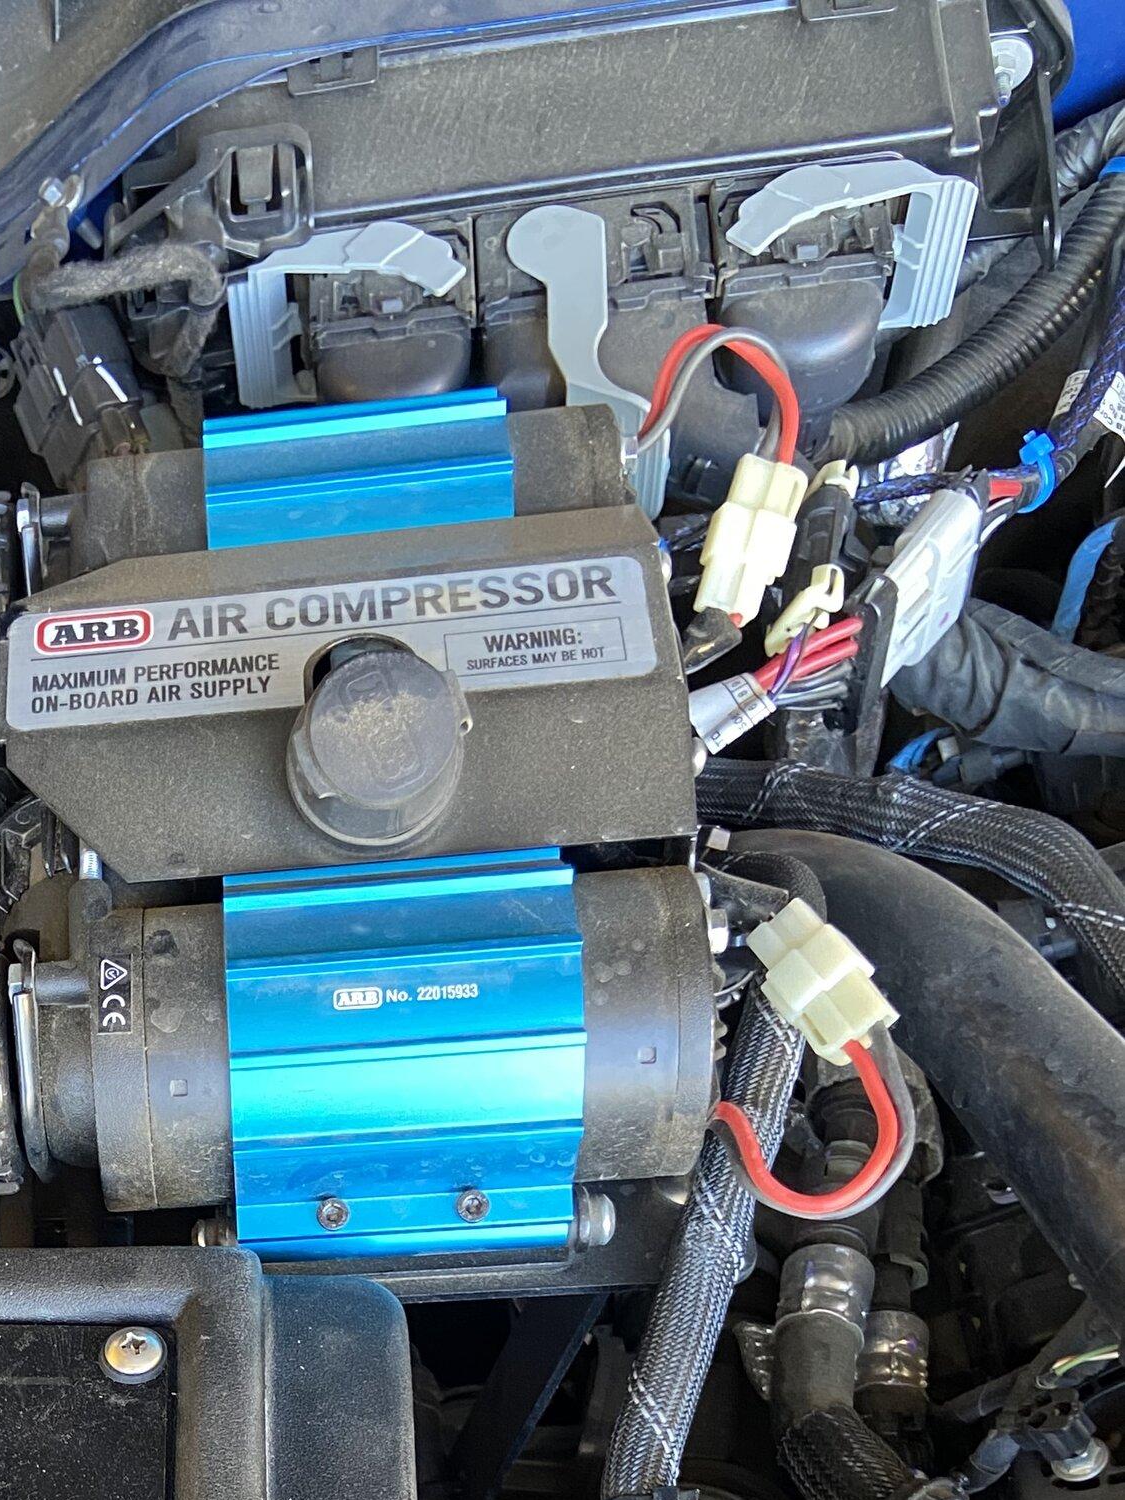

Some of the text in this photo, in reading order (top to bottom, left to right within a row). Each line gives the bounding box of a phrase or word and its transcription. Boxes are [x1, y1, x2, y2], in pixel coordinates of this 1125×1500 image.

[49, 564, 617, 646] ARB AIR COMPRESSOR
[483, 628, 583, 653] WARNING:
[31, 653, 280, 693] MAXIMUM PERFORMANCE
[467, 645, 605, 671] SURFACES MAY BE HOT
[31, 676, 272, 715] ON-BOARD AIR SUPPLY
[337, 983, 479, 1007] ARB No. 22015933
